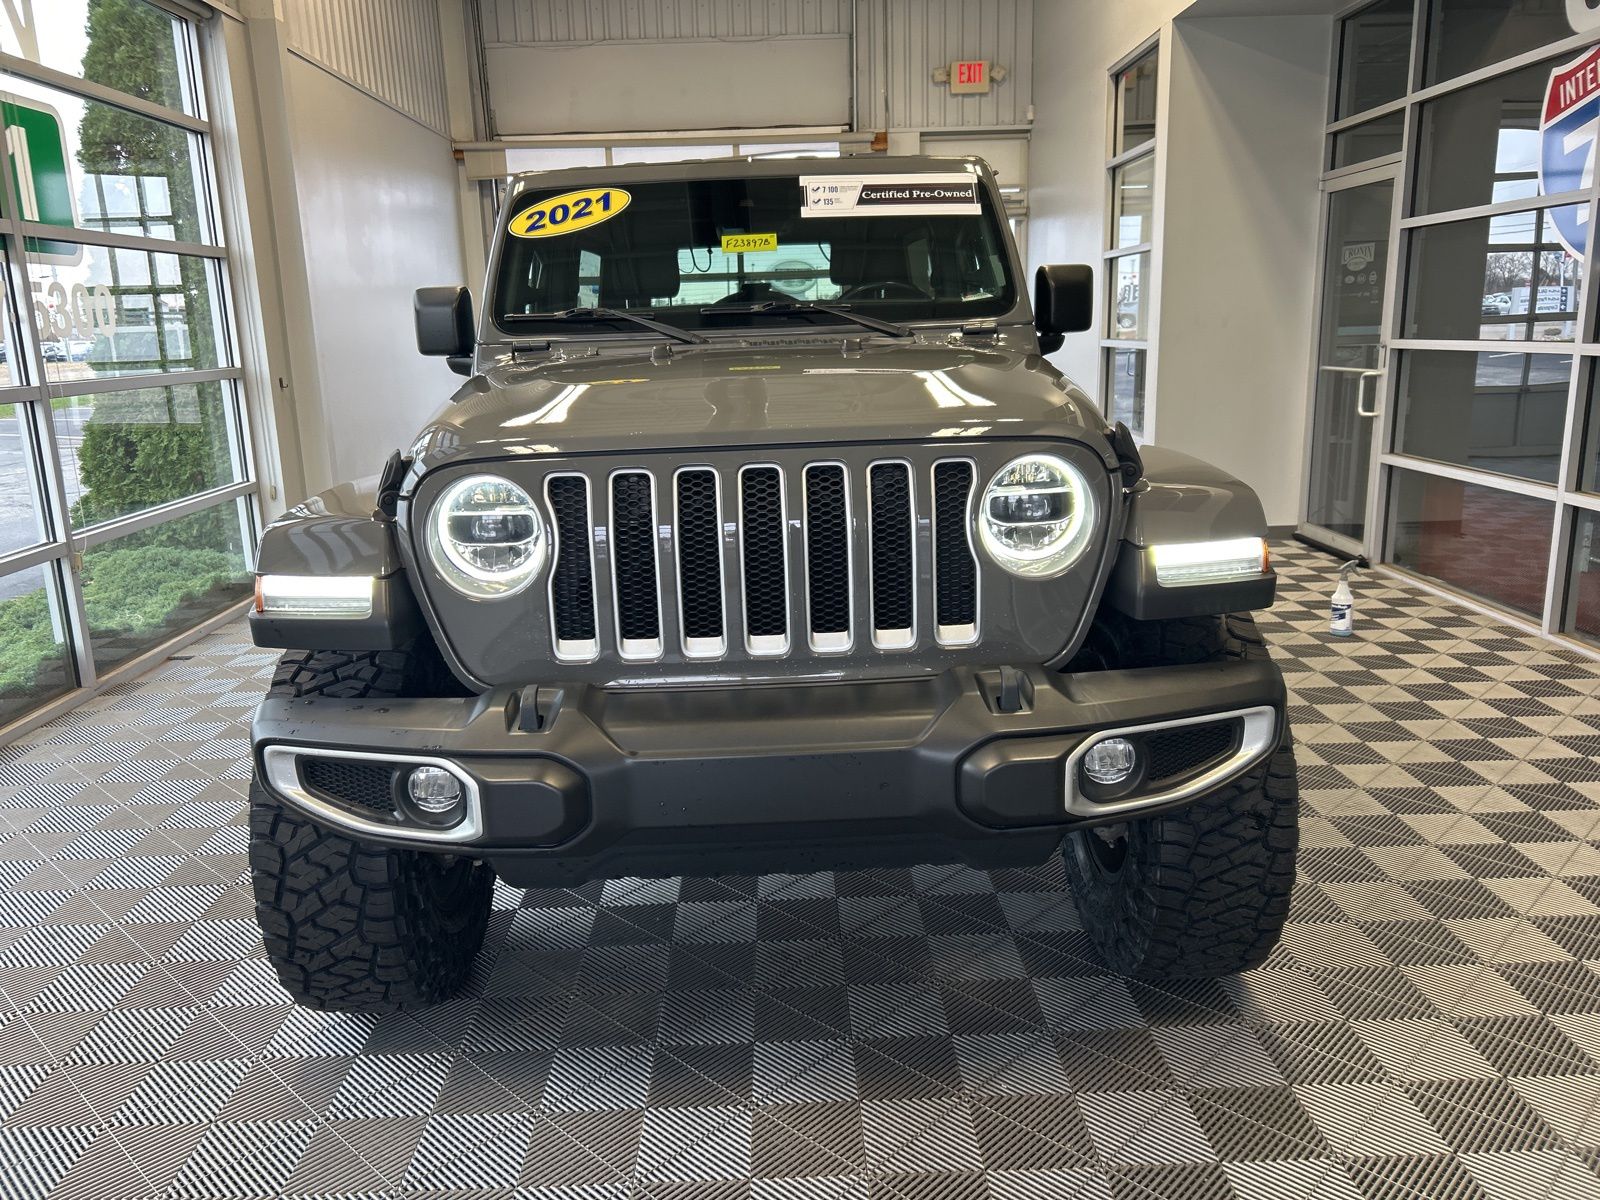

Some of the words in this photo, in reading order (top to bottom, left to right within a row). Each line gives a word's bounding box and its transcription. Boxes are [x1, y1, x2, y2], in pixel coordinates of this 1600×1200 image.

[958, 63, 983, 84] EXIT
[1559, 58, 1600, 109] INTE
[861, 190, 910, 199] Certified
[912, 189, 973, 198] Pre-Owned
[525, 191, 612, 233] 2021
